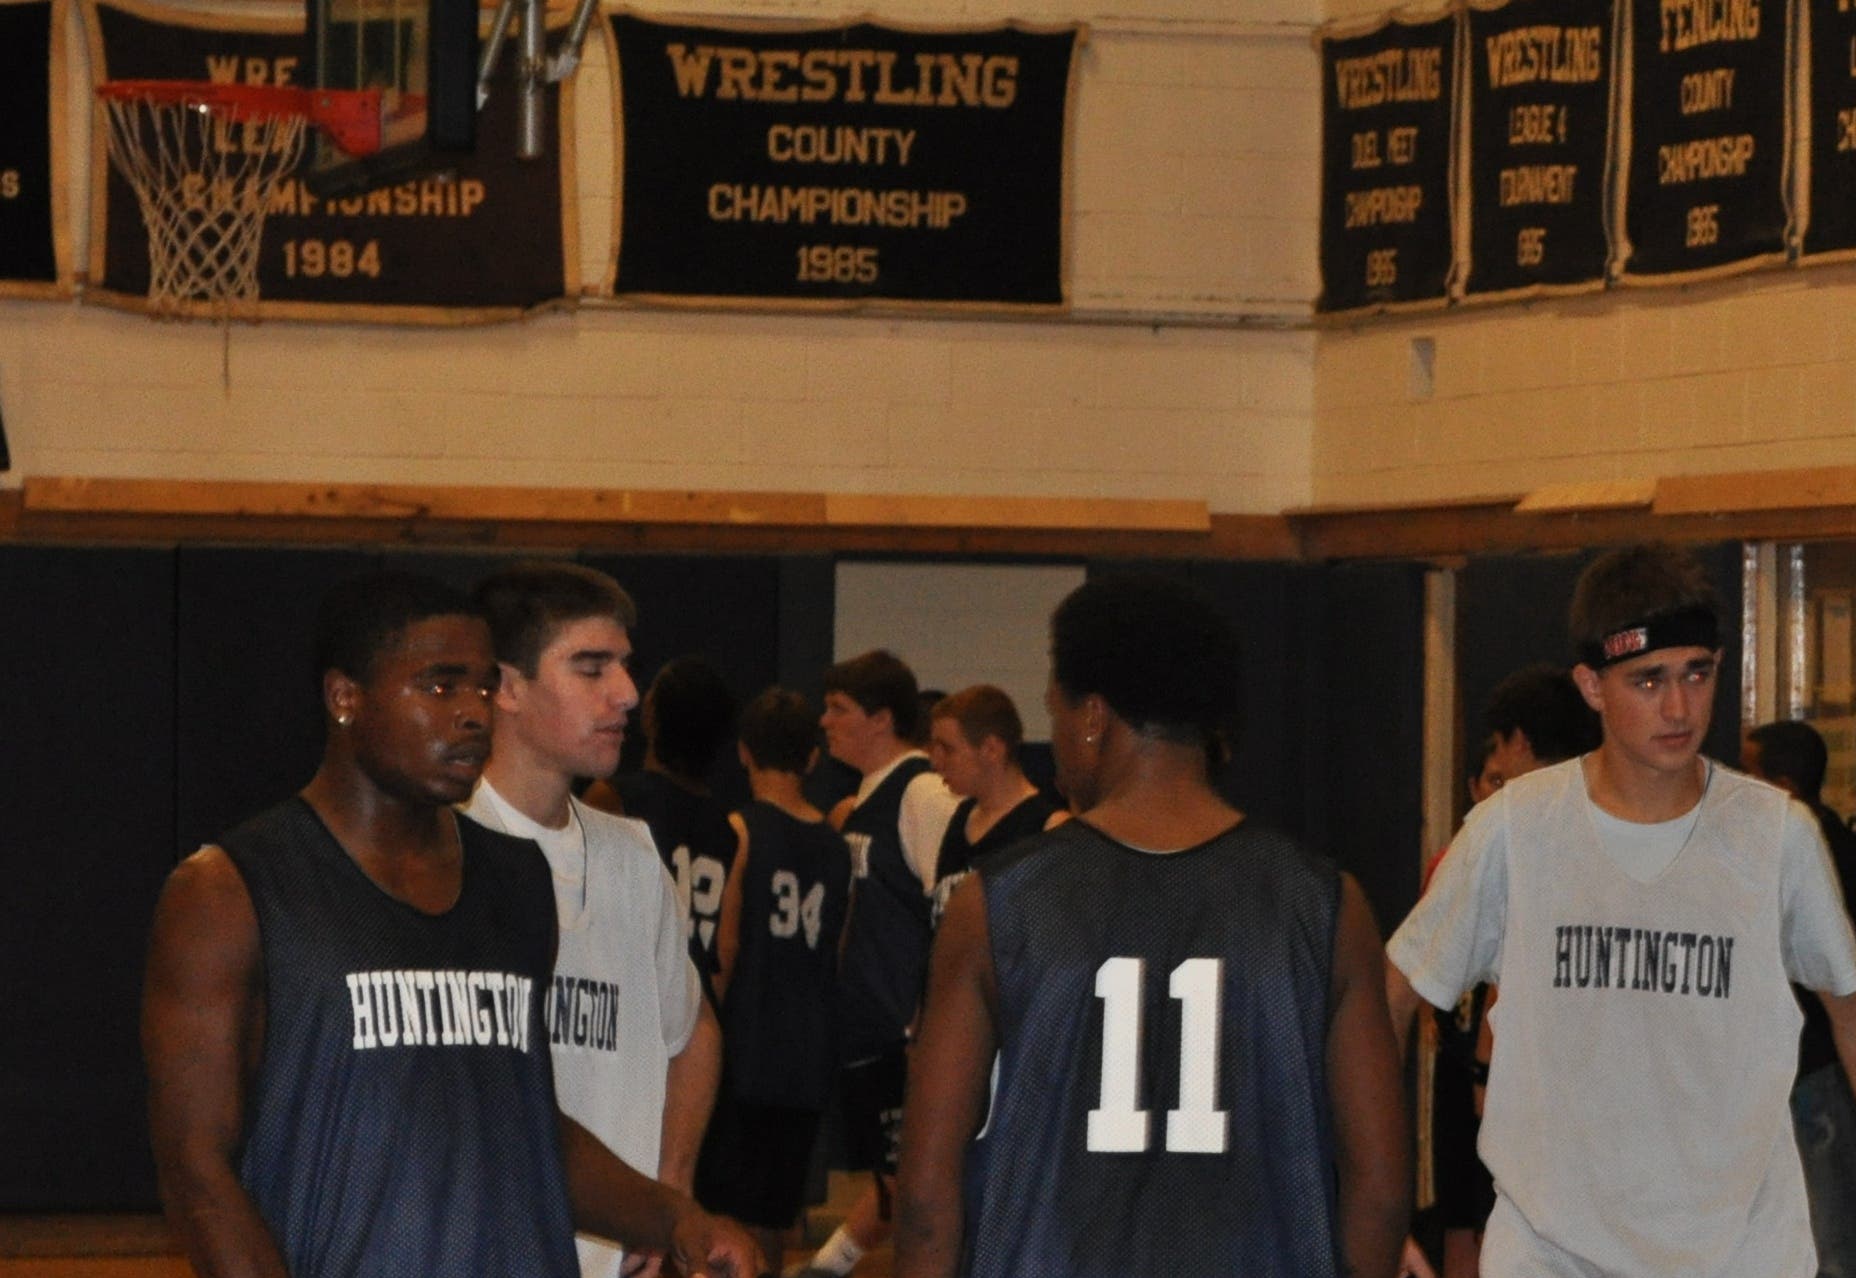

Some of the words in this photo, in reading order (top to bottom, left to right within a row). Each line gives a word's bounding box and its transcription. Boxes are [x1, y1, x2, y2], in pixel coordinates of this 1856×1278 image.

[665, 43, 1020, 109] WRESTLING
[1334, 46, 1442, 110] WRESTLING
[1485, 24, 1602, 89] WRESTLING
[1680, 67, 1737, 116] COUNTY
[766, 123, 918, 165] COUNTY
[1658, 133, 1757, 185] CHAMPIONSHIP
[707, 182, 968, 230] CHAMPIONSHIP
[283, 238, 383, 279] 1984
[796, 245, 880, 284] 1985
[769, 868, 826, 951] 34
[1553, 925, 1736, 999] HUNTINGTON
[346, 969, 533, 1054] HUNTINGTON
[552, 975, 620, 1052] NGTON
[1086, 956, 1229, 1154] 11
